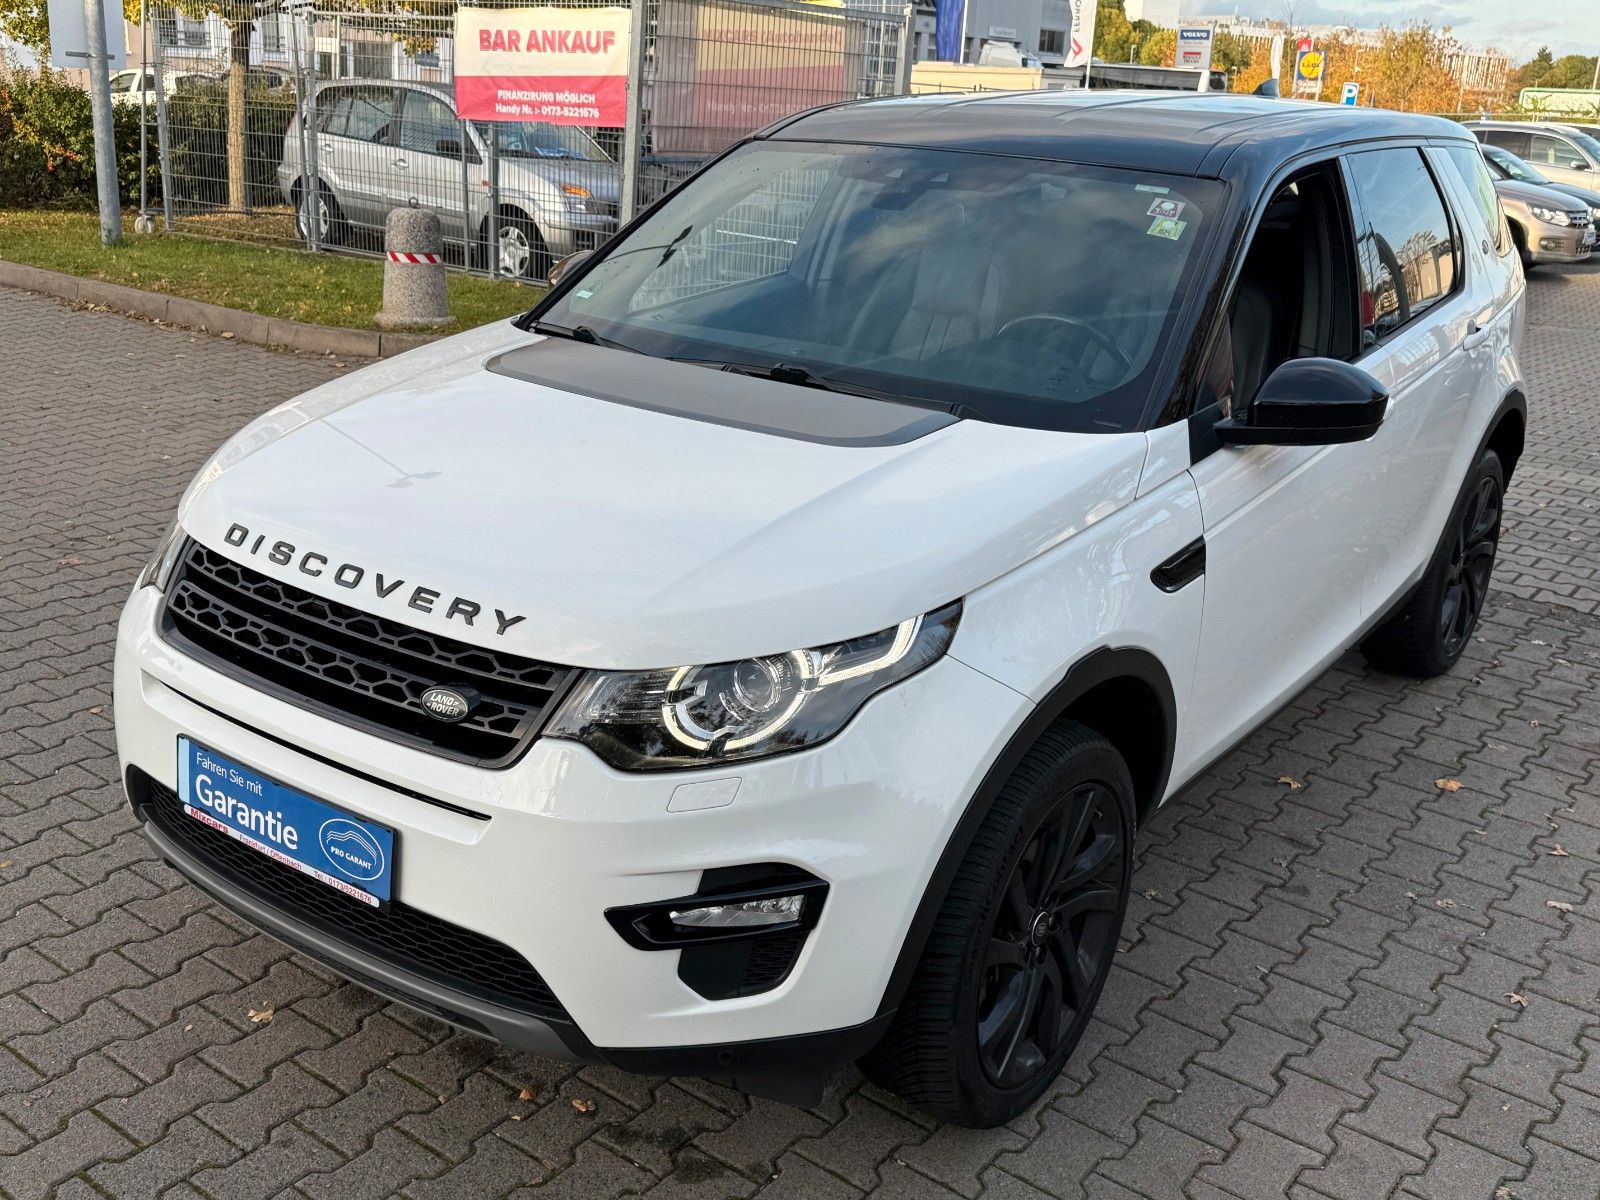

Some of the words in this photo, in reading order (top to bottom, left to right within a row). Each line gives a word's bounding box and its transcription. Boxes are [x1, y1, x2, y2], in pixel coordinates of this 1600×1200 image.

[479, 29, 521, 52] BAR
[526, 30, 615, 54] ANKAUF
[497, 89, 555, 102] FINANZIRUNG
[556, 90, 596, 104] MÖGLICH
[1343, 84, 1357, 104] P
[495, 102, 521, 116] Handy
[223, 522, 527, 636] DISCOVERY
[430, 693, 455, 706] LAND
[431, 702, 460, 716] ROVER
[196, 752, 228, 778] Fahren
[229, 769, 244, 787] Sie
[246, 779, 262, 797] mit
[195, 774, 298, 850] Garantie
[190, 808, 229, 834] Mixcars
[270, 849, 302, 871] Offenbach
[328, 877, 372, 904] 0173/5221676
[330, 846, 345, 858] PRO
[345, 853, 373, 870] GARANT
